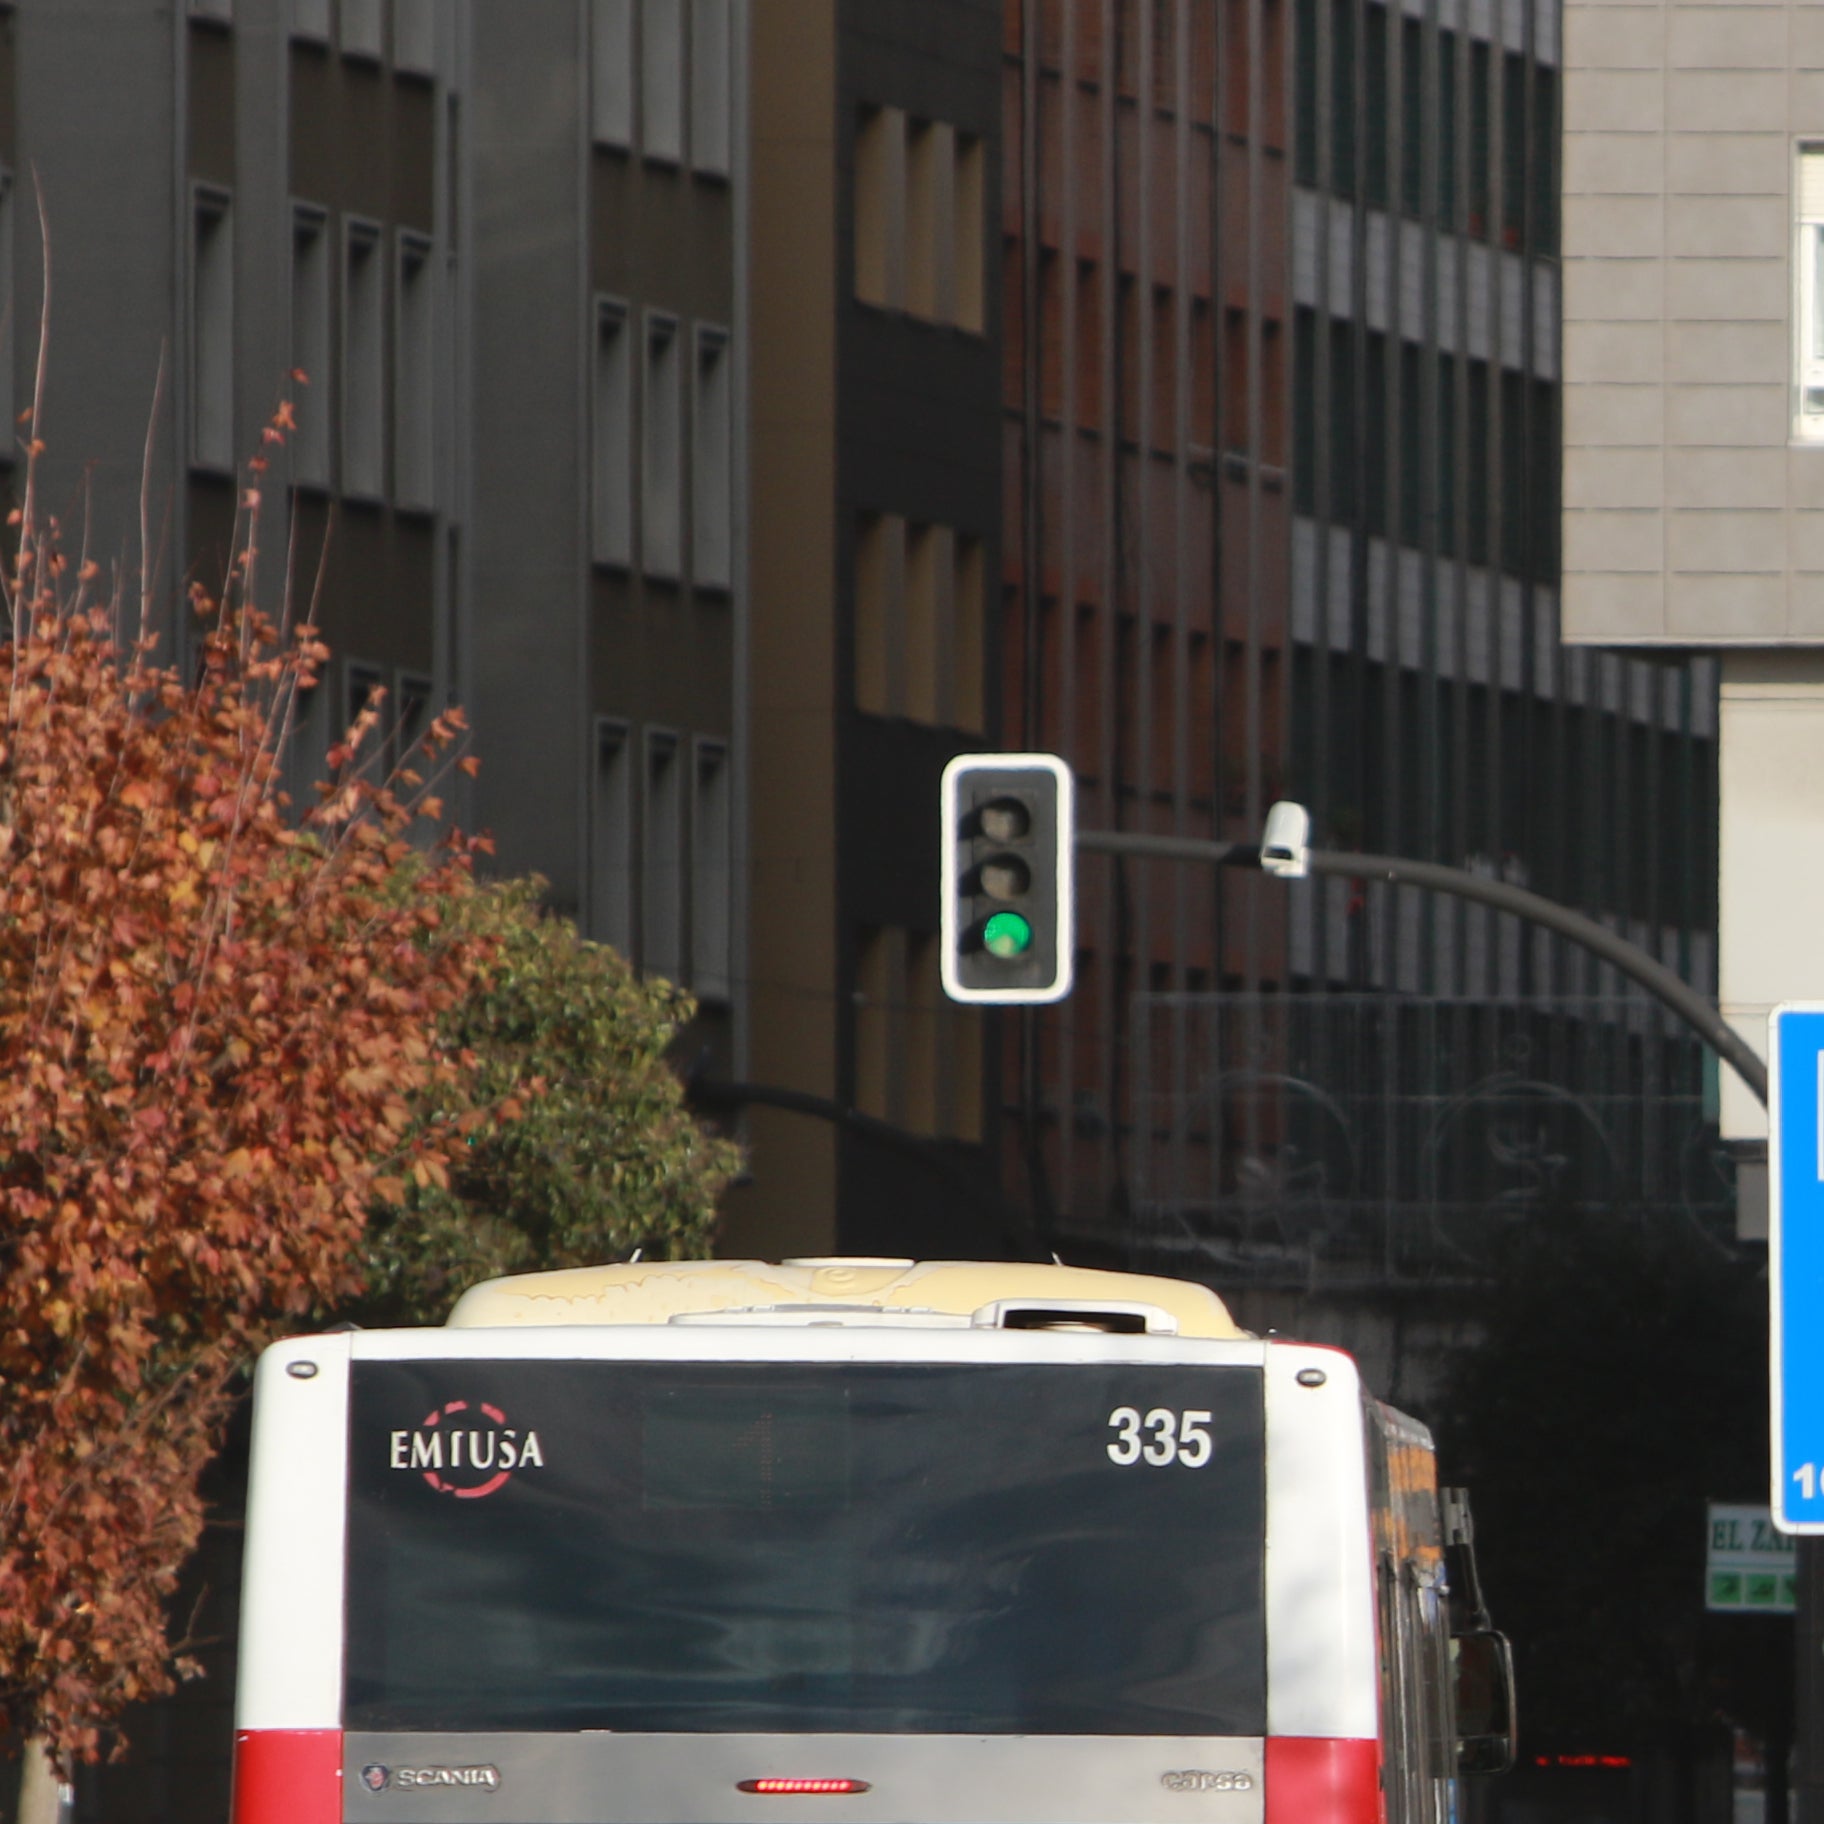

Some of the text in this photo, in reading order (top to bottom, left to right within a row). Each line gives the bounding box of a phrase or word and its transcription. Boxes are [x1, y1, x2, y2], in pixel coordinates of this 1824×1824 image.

[390, 1430, 544, 1470] EMTUSA
[1106, 1406, 1213, 1469] 335
[1712, 1519, 1744, 1551] EL
[397, 1769, 498, 1787] SCANIA
